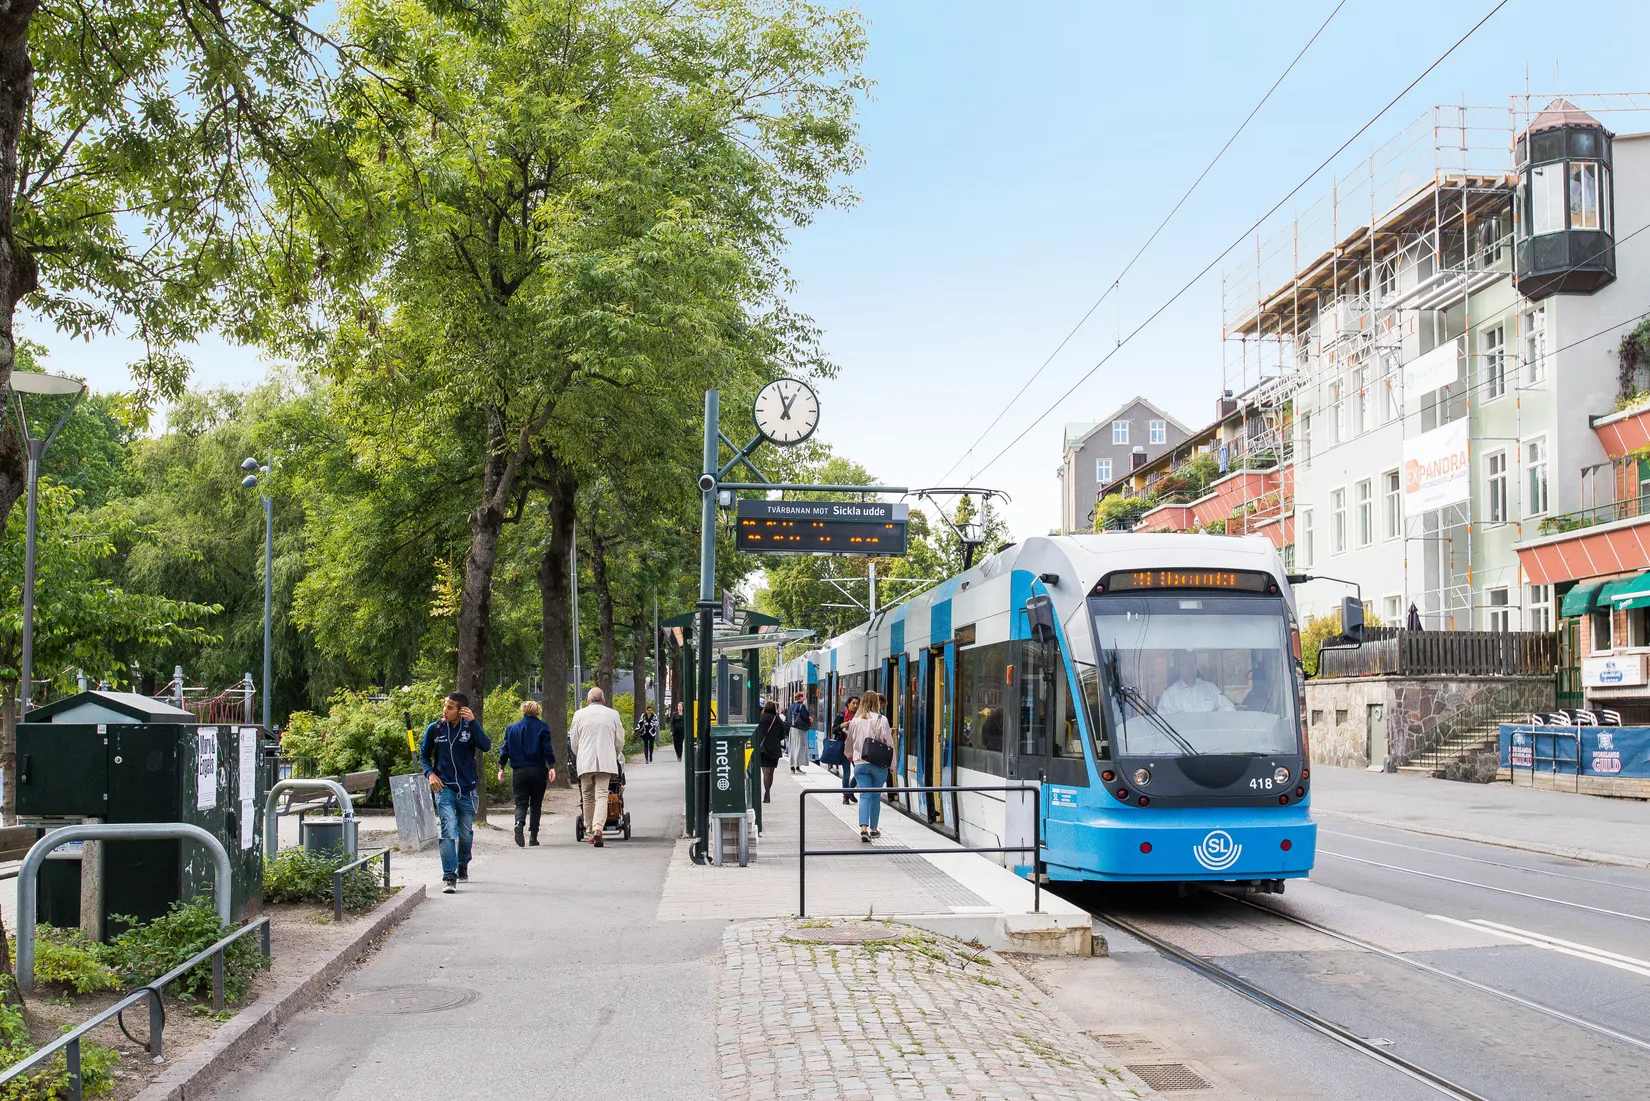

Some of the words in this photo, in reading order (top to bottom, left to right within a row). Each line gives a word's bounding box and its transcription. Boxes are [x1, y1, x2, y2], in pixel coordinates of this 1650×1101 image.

[767, 506, 811, 514] TVÄRBANAN
[833, 506, 861, 516] Sickla
[863, 507, 885, 516] udde
[1592, 758, 1621, 773] GUILD
[1249, 778, 1273, 789] 418
[1208, 838, 1228, 853] SL
